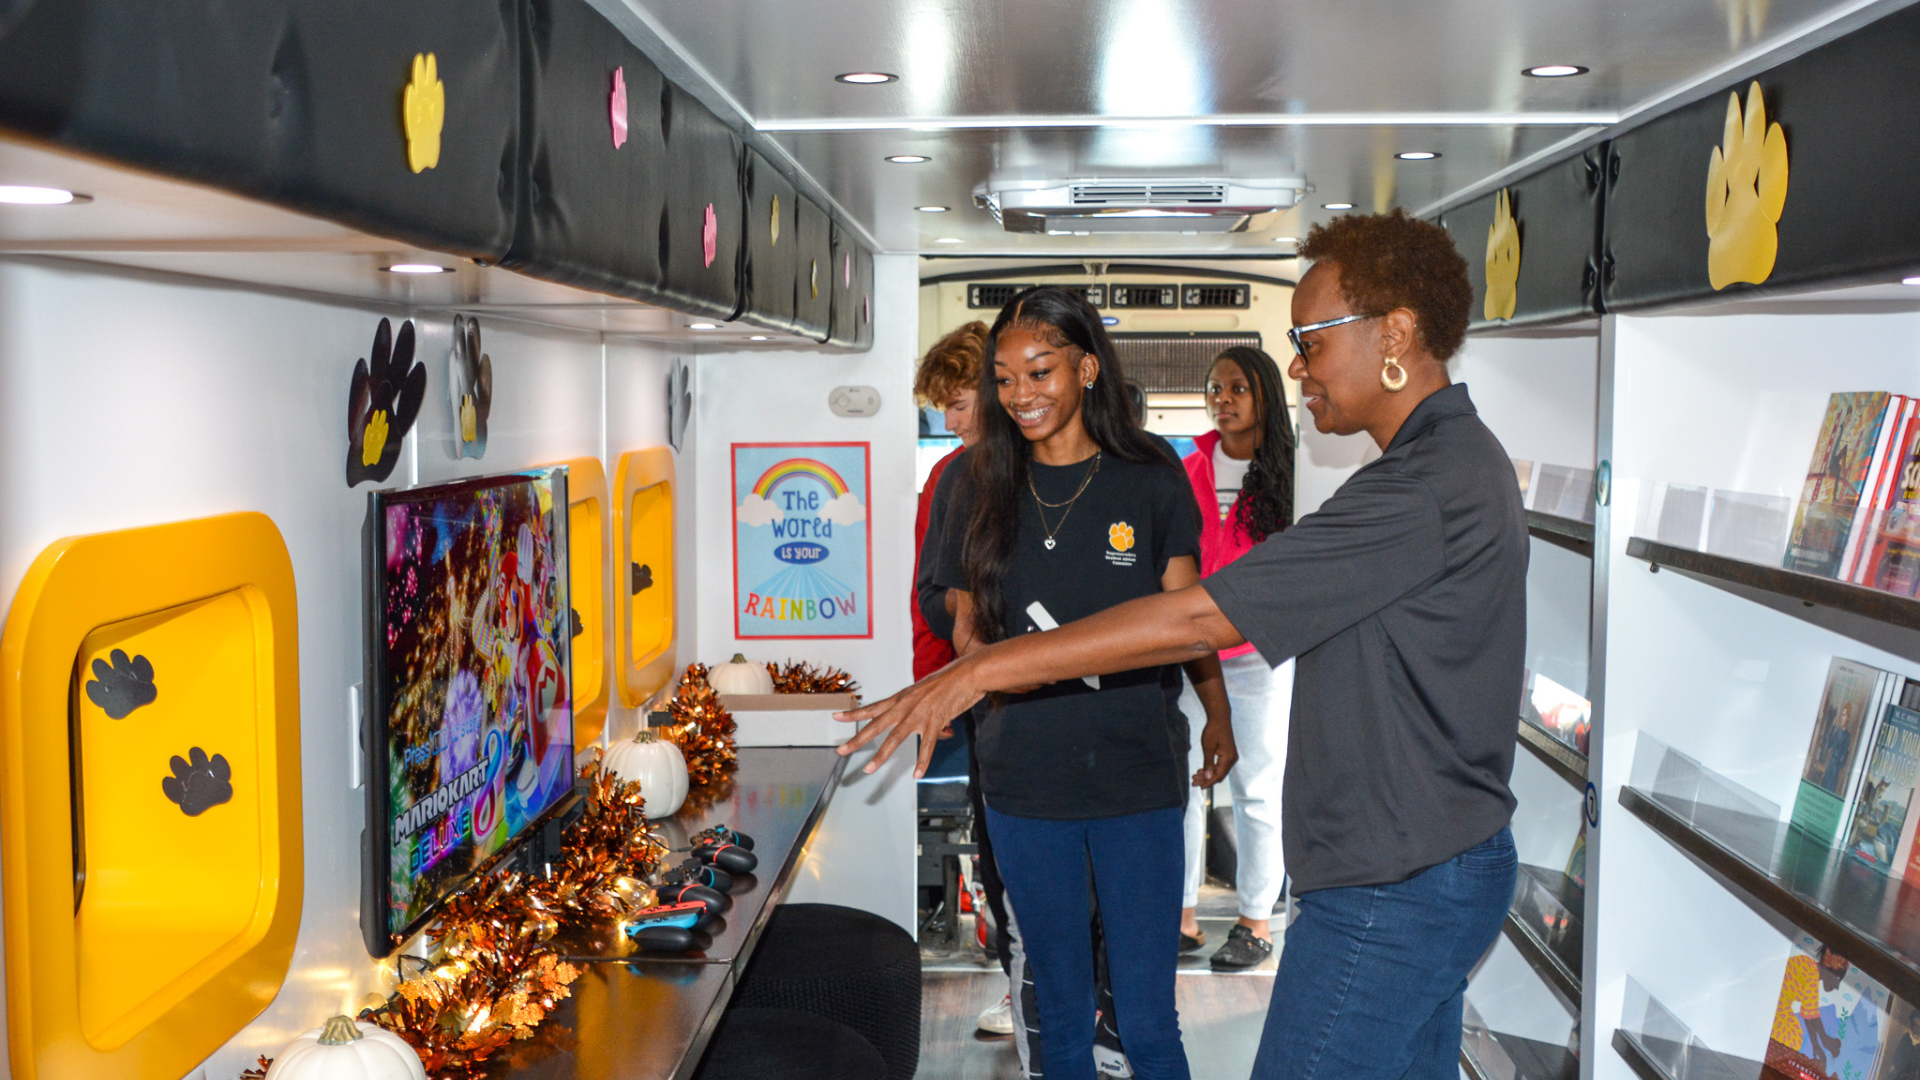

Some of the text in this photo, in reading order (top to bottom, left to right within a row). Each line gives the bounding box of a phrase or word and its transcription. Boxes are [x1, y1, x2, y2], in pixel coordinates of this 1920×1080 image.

[783, 490, 819, 511] The
[782, 547, 822, 560] is your
[744, 592, 857, 621] RAINBOW
[473, 728, 503, 838] 8
[409, 807, 470, 877] DELUXE
